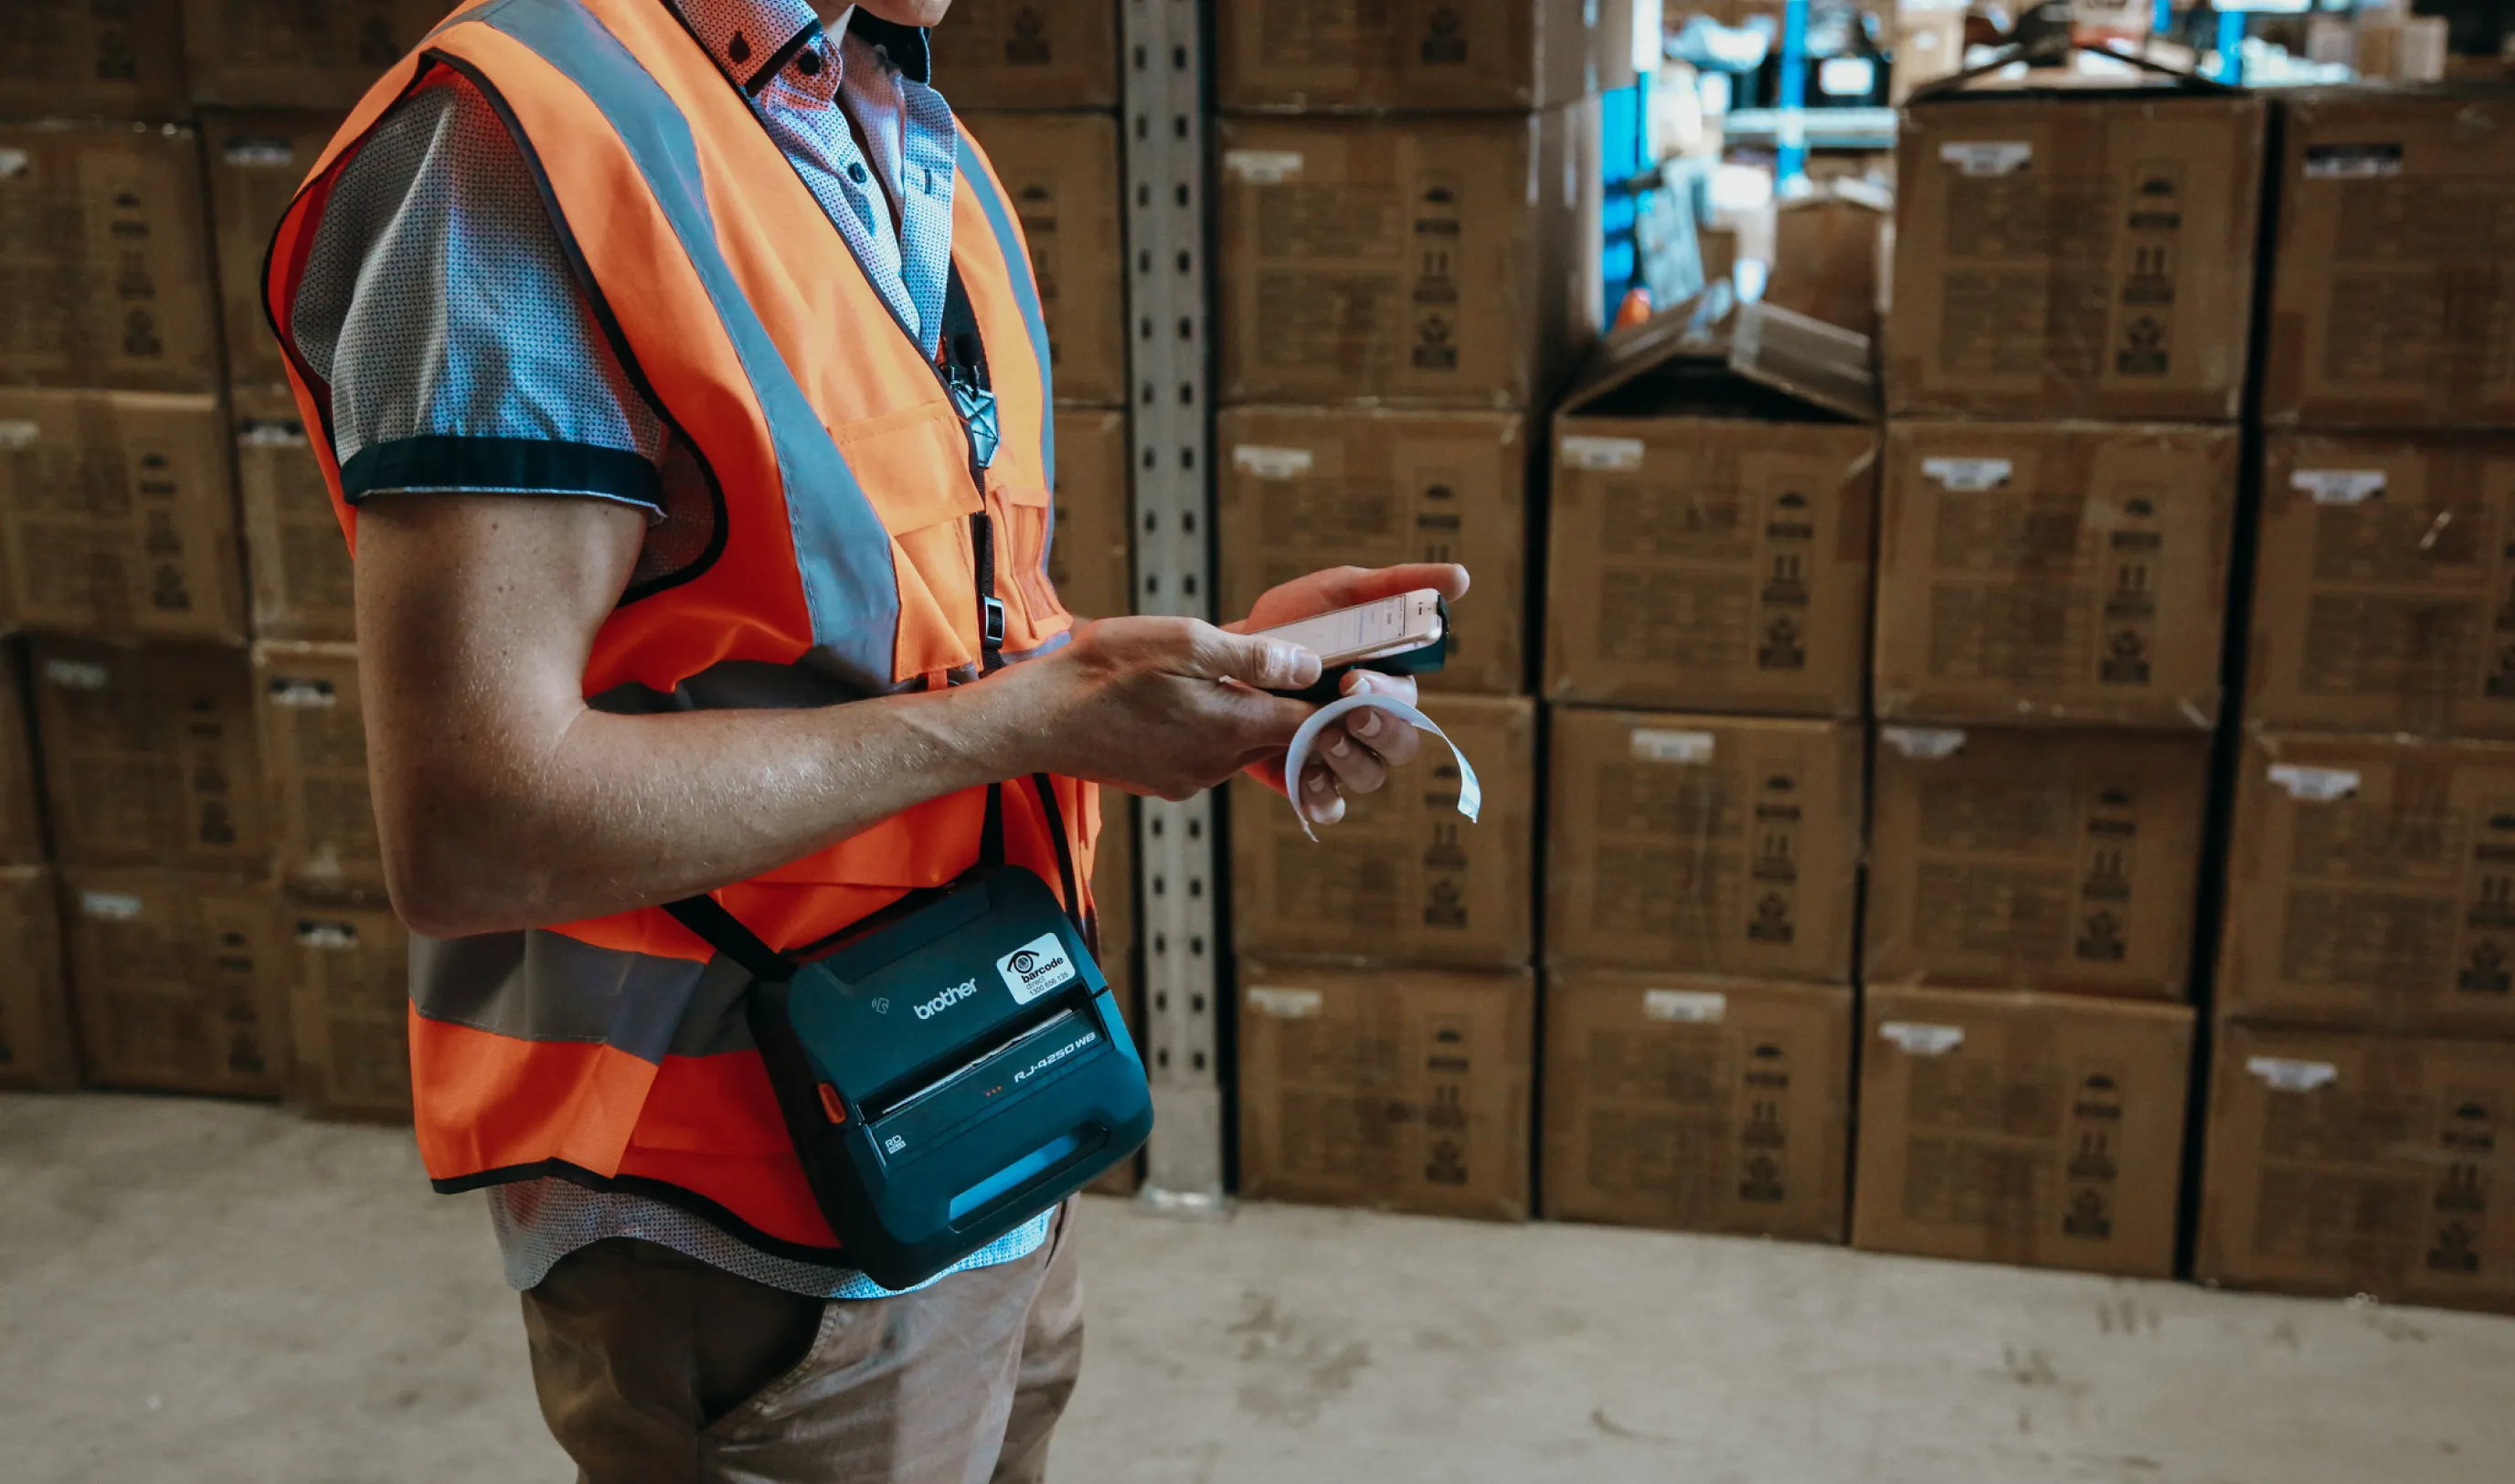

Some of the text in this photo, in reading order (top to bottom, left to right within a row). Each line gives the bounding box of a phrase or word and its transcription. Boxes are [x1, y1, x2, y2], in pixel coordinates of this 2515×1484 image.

[1021, 957, 1064, 984] barcode
[1026, 976, 1046, 990] direct
[1029, 984, 1045, 996] 1300
[1056, 971, 1069, 981] 135
[913, 978, 977, 1019] brother
